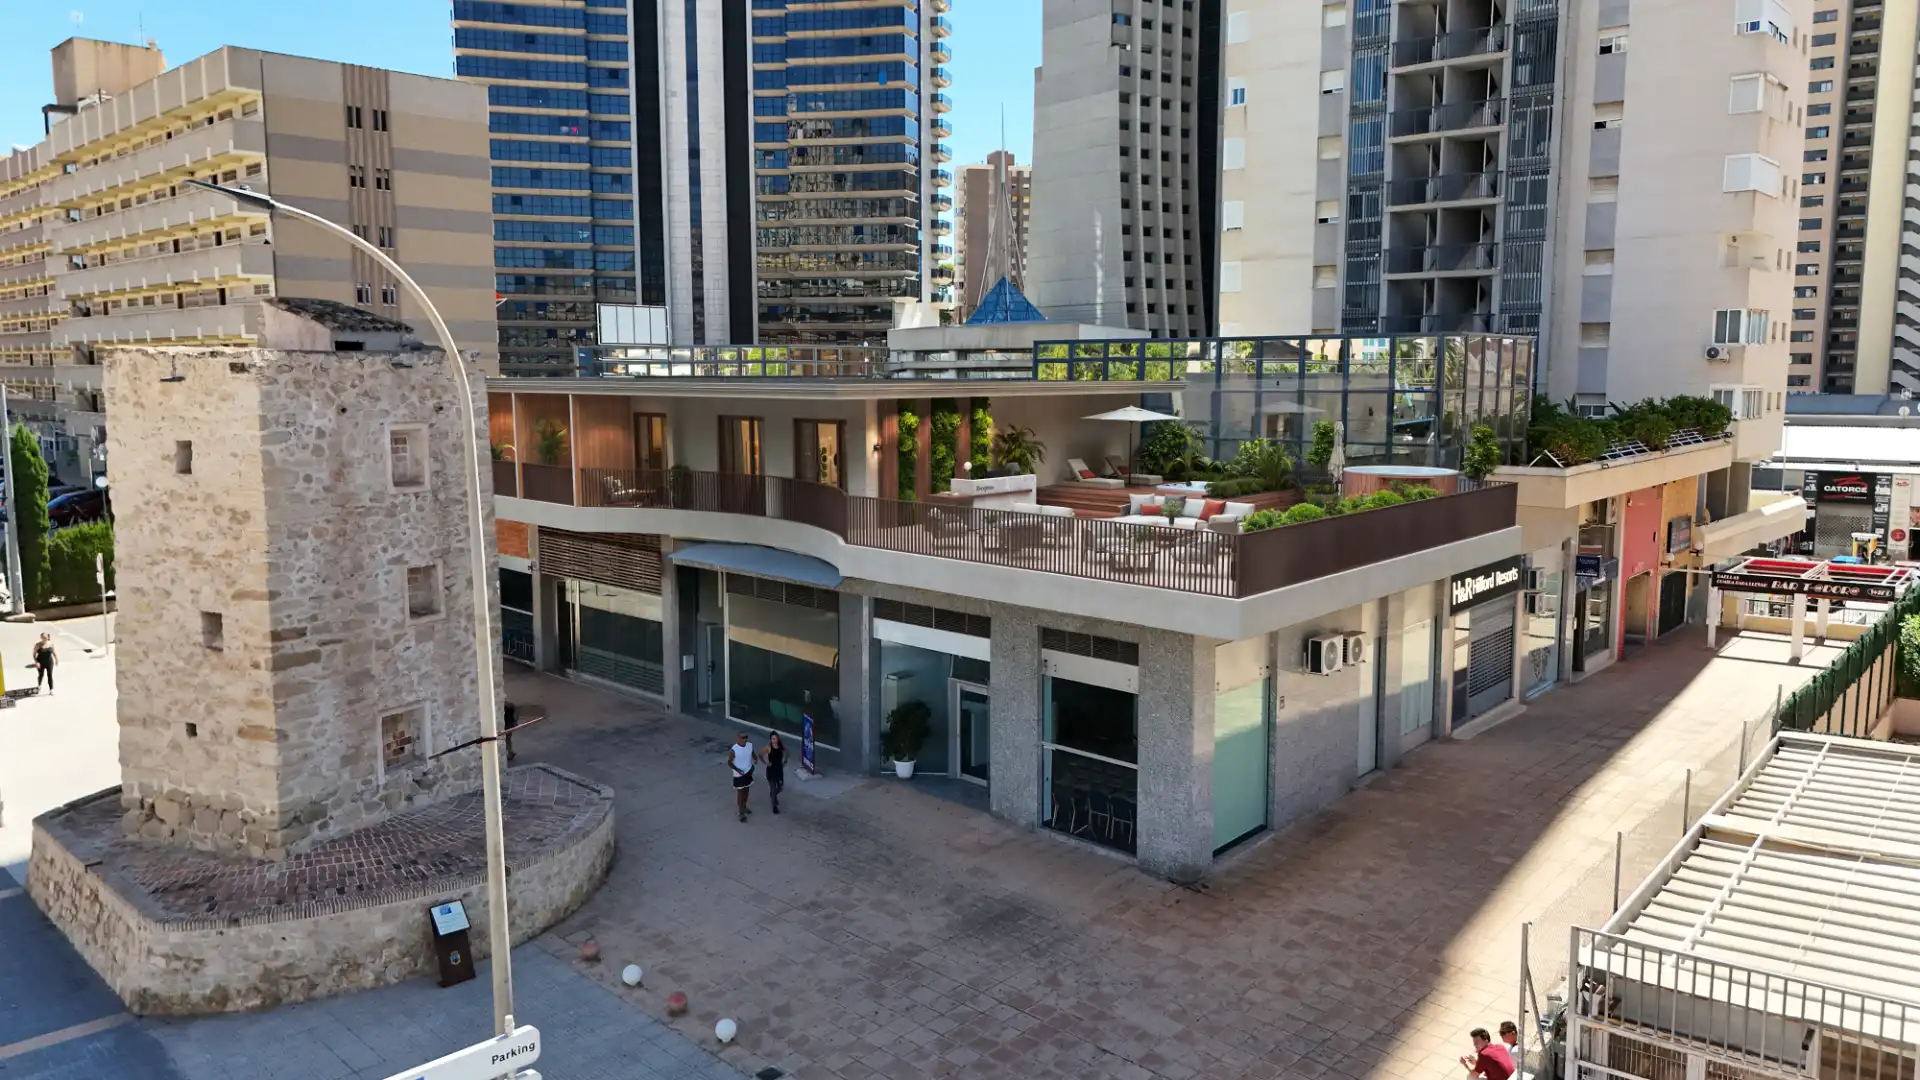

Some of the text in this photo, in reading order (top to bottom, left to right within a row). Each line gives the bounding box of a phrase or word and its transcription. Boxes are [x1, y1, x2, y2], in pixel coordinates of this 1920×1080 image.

[1823, 485, 1868, 493] CATORCE
[1452, 577, 1473, 606] H&R
[1495, 566, 1518, 587] Resorts
[1771, 580, 1799, 591] BAR
[491, 1041, 536, 1065] Parking
